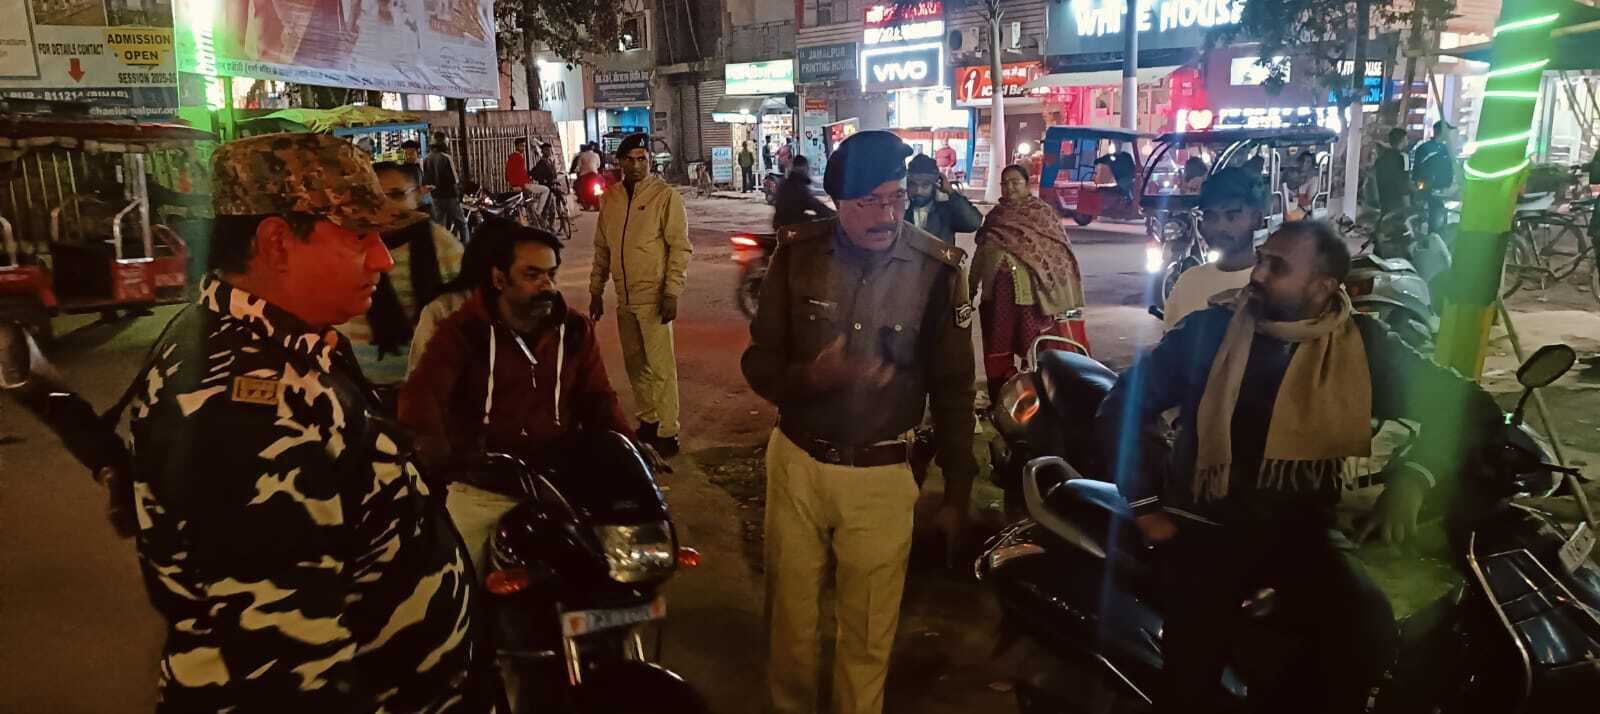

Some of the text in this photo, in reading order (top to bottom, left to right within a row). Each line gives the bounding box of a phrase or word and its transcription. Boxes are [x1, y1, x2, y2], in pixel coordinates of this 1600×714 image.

[1159, 0, 1247, 33] HOUSE
[107, 34, 171, 45] ADMISSION
[78, 43, 104, 56] CONTACT
[124, 50, 159, 61] OPEN
[118, 72, 149, 83] SESSION
